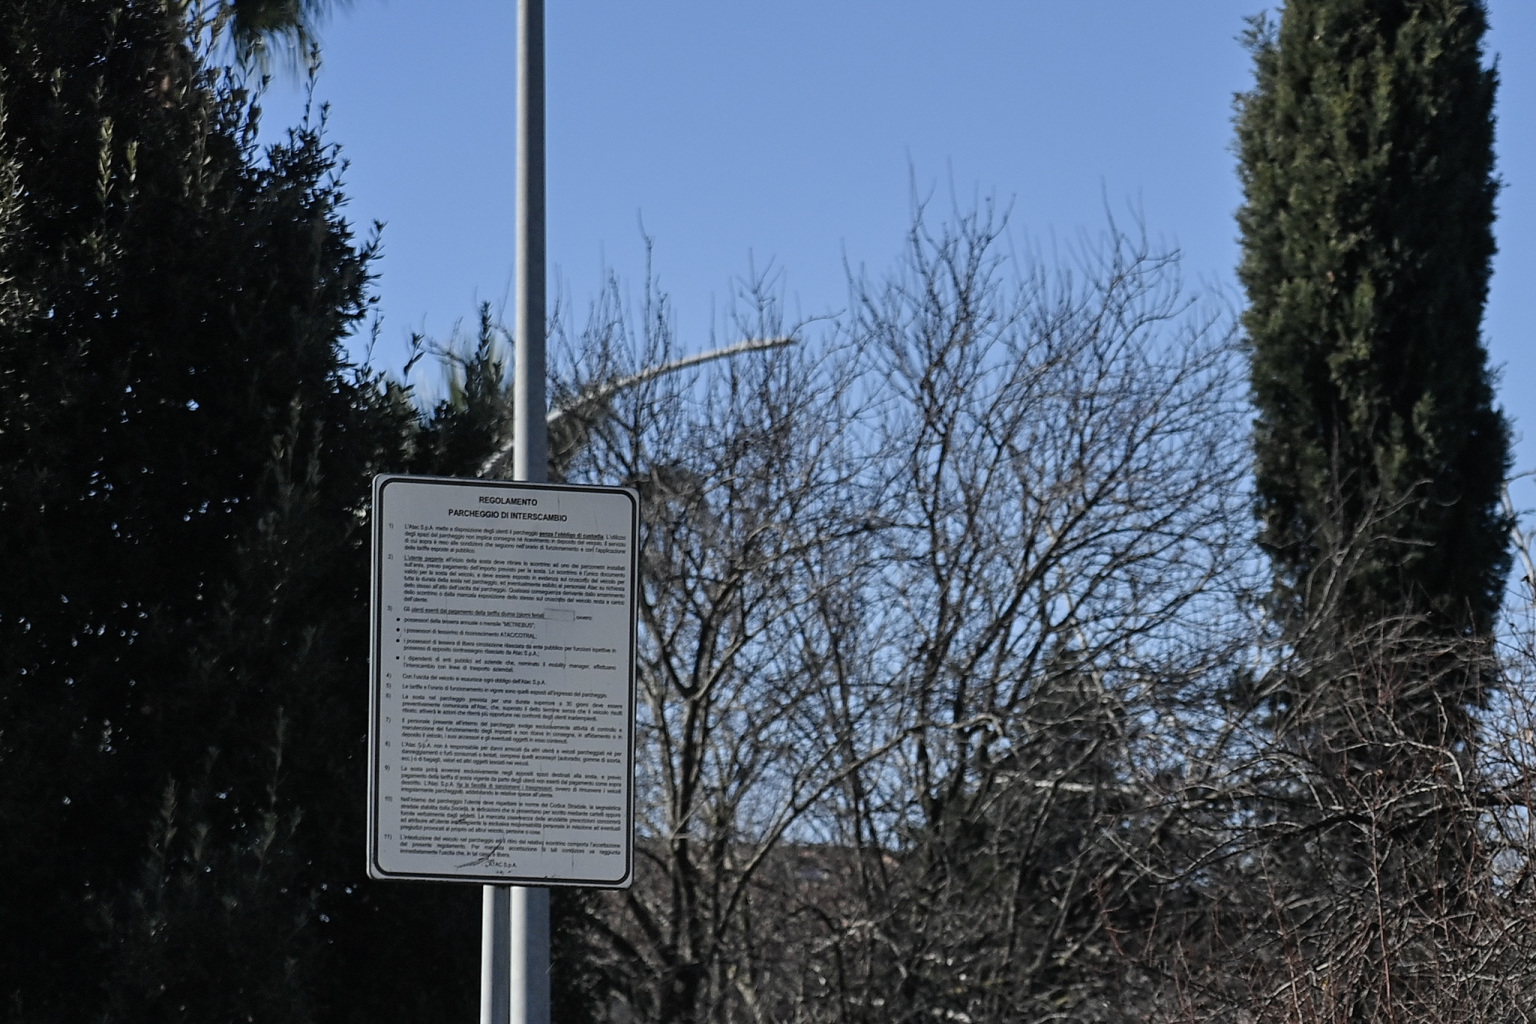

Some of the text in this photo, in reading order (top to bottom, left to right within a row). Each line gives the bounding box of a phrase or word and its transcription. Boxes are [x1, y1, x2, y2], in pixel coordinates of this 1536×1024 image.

[479, 496, 538, 506] REGOLAMENTO
[448, 508, 568, 522] PARCHEGGIO DI INTERSCAMBIO
